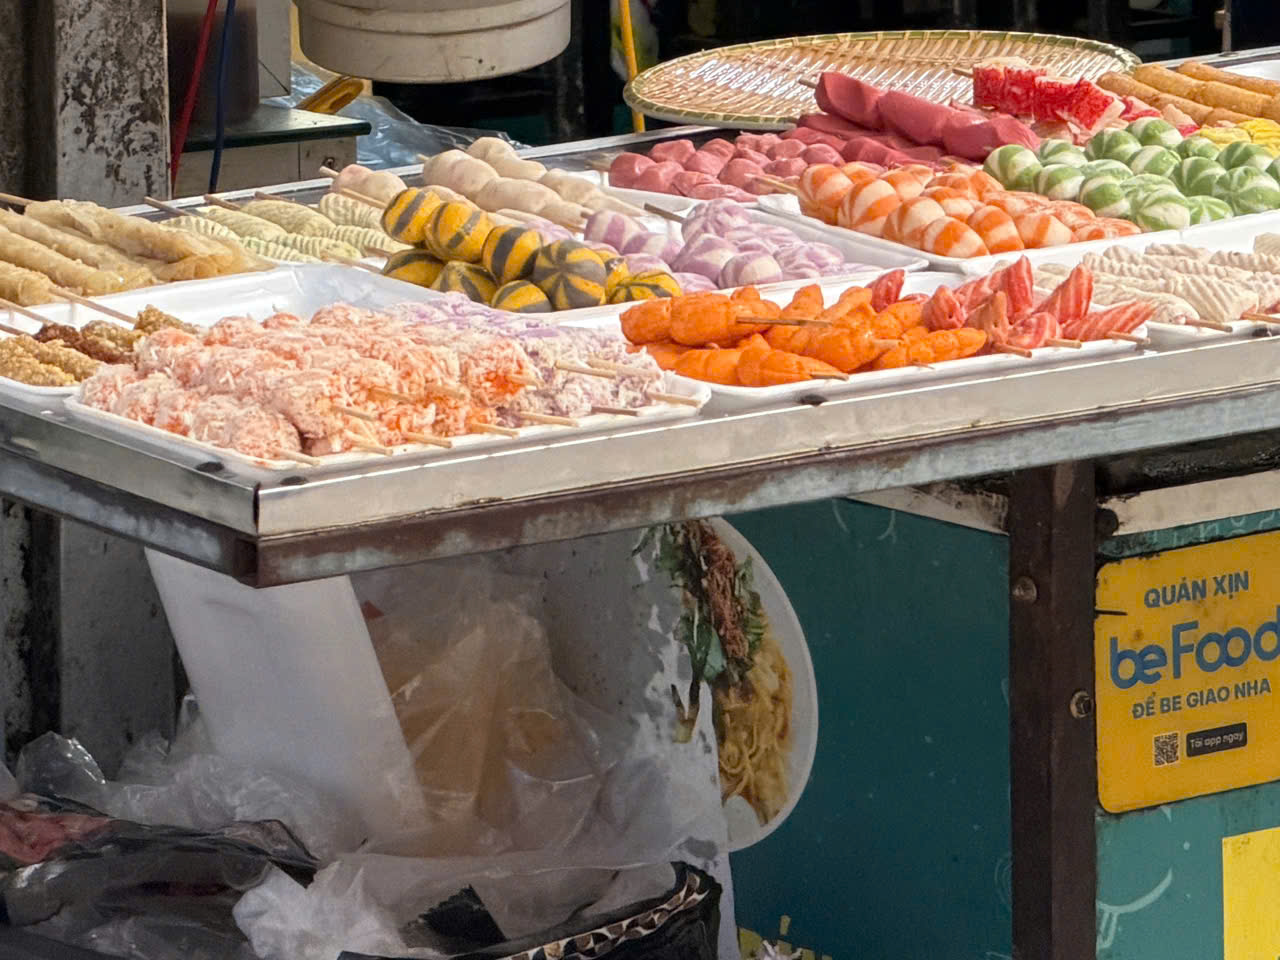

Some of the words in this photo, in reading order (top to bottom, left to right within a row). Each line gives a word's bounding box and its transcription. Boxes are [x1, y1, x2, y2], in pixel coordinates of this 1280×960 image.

[1143, 577, 1206, 608] QUÁN
[1213, 570, 1249, 599] XỊN
[1131, 692, 1156, 719] ĐỂ
[1160, 695, 1182, 714] BE
[1186, 686, 1230, 709] GIAO
